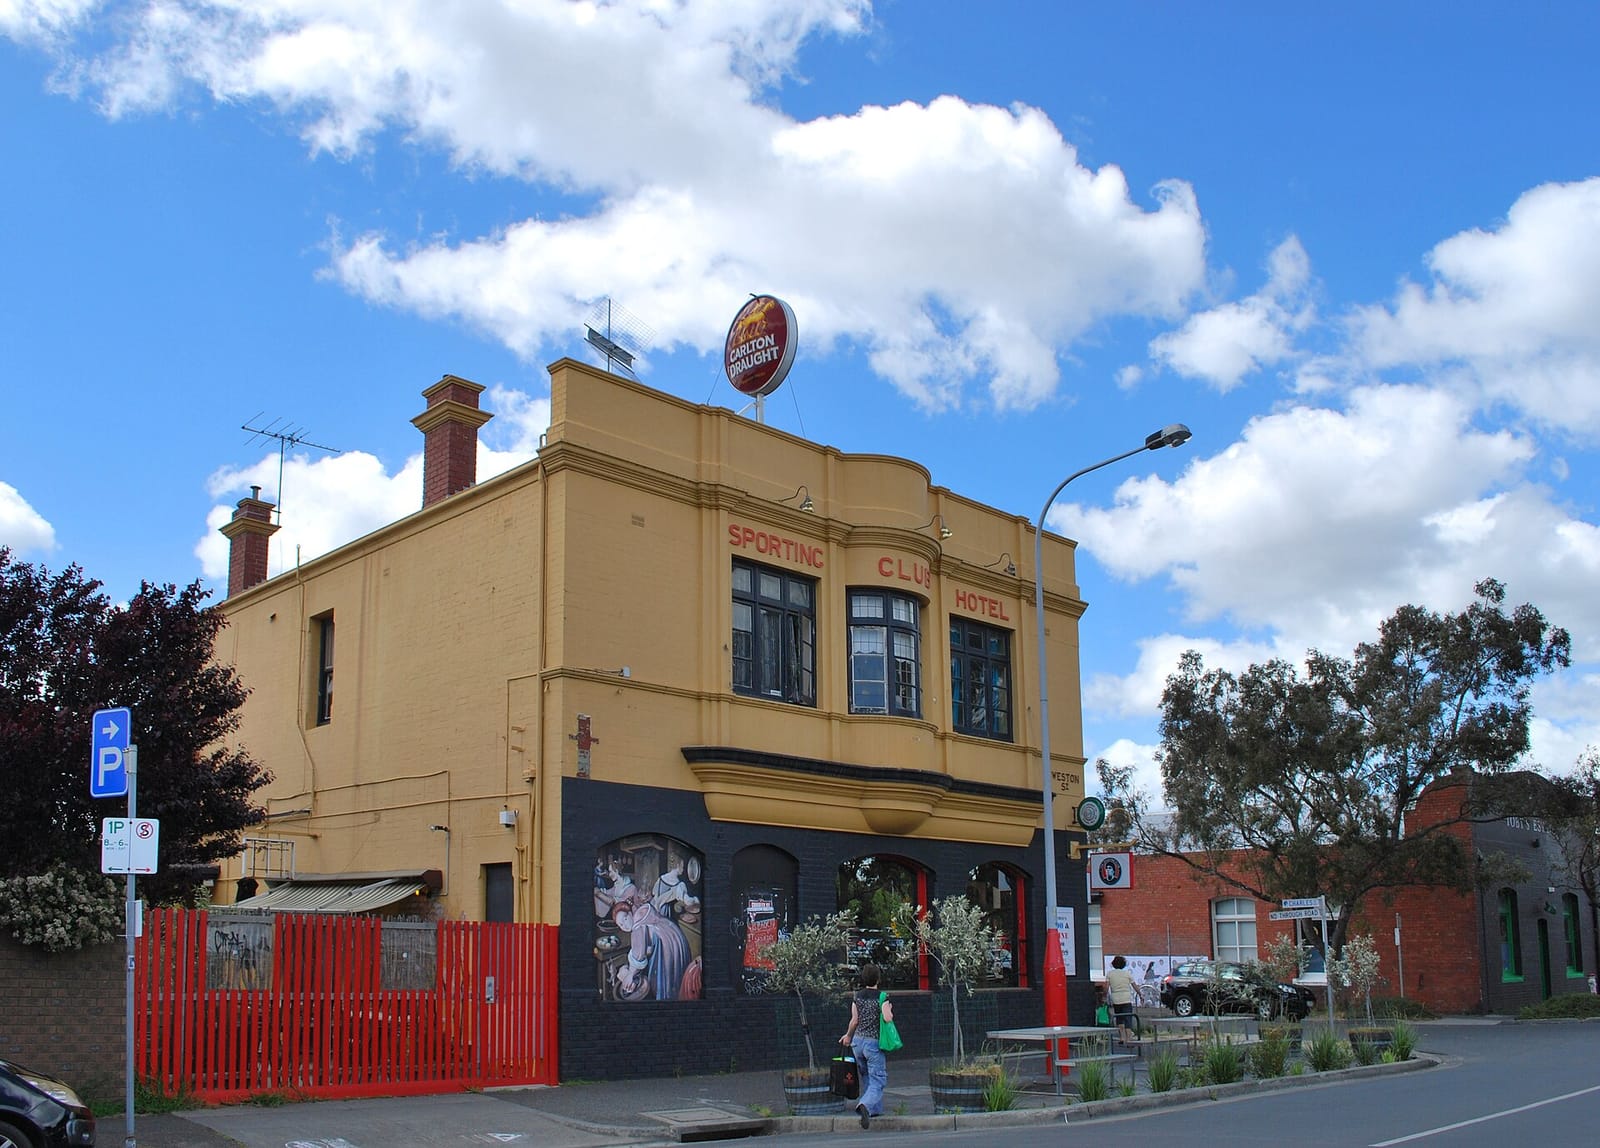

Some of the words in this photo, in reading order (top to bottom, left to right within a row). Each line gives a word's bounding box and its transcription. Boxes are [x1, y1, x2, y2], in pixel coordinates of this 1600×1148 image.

[729, 346, 779, 377] DRAUGHT
[730, 334, 775, 362] CARLTON
[878, 557, 931, 589] CLUB
[955, 589, 1009, 621] HOTEL
[98, 747, 122, 786] P
[108, 821, 125, 834] 1P
